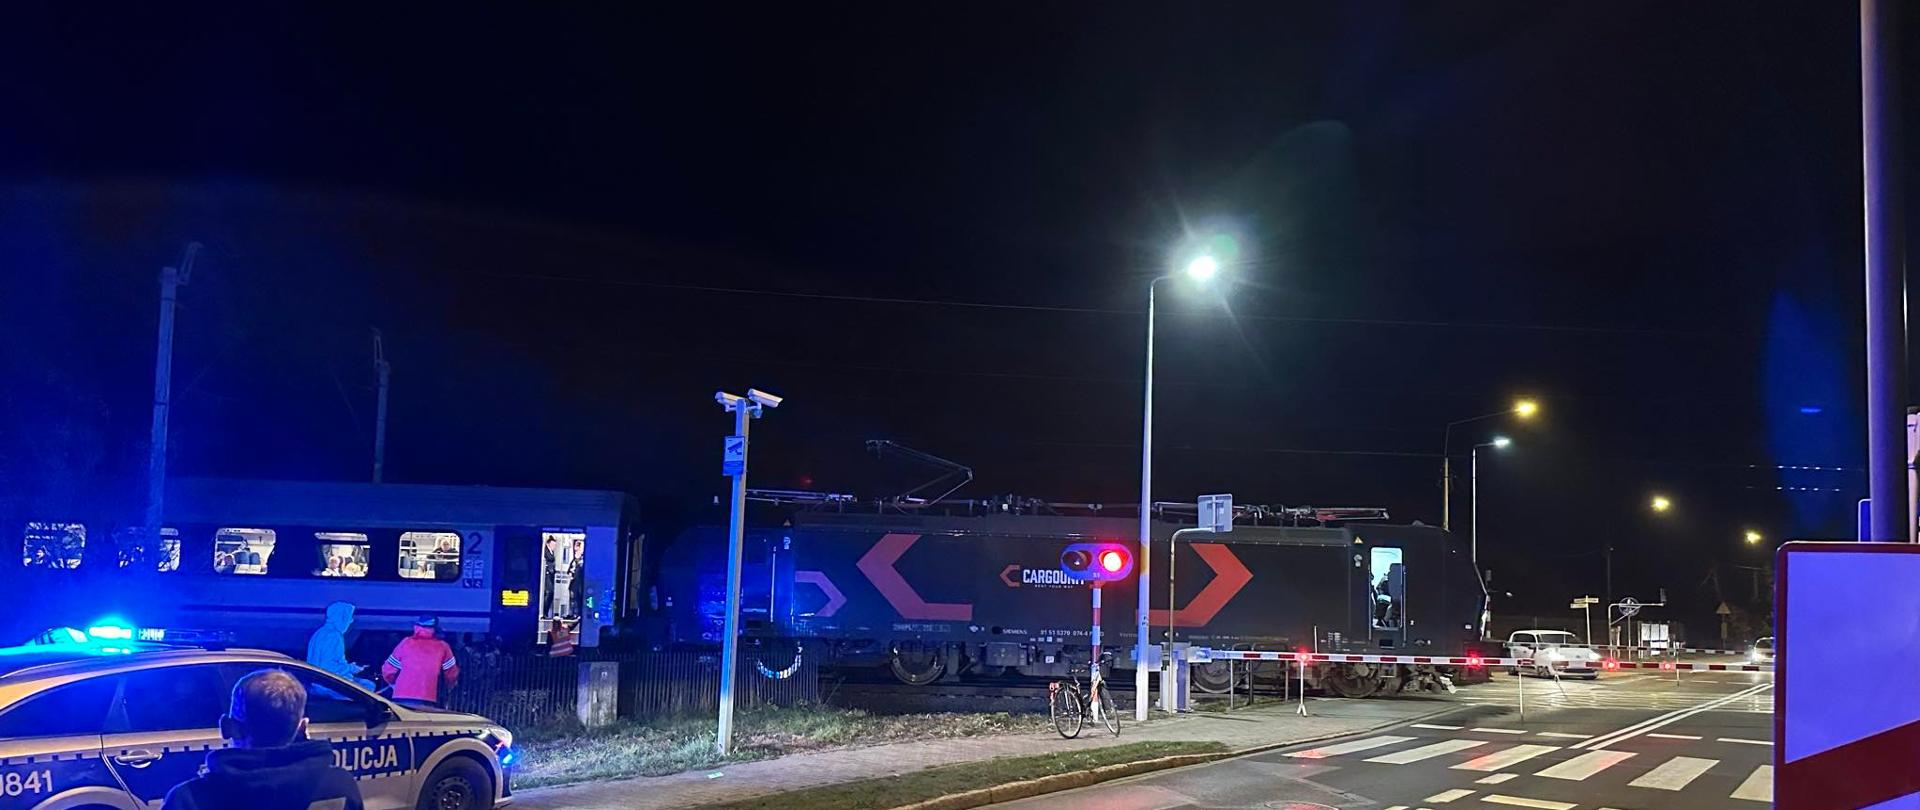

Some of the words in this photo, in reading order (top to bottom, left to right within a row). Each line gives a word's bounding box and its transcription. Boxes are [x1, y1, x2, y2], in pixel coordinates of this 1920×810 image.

[467, 531, 483, 554] 2
[1022, 569, 1084, 585] CARGOU
[329, 744, 398, 771] OLICJA
